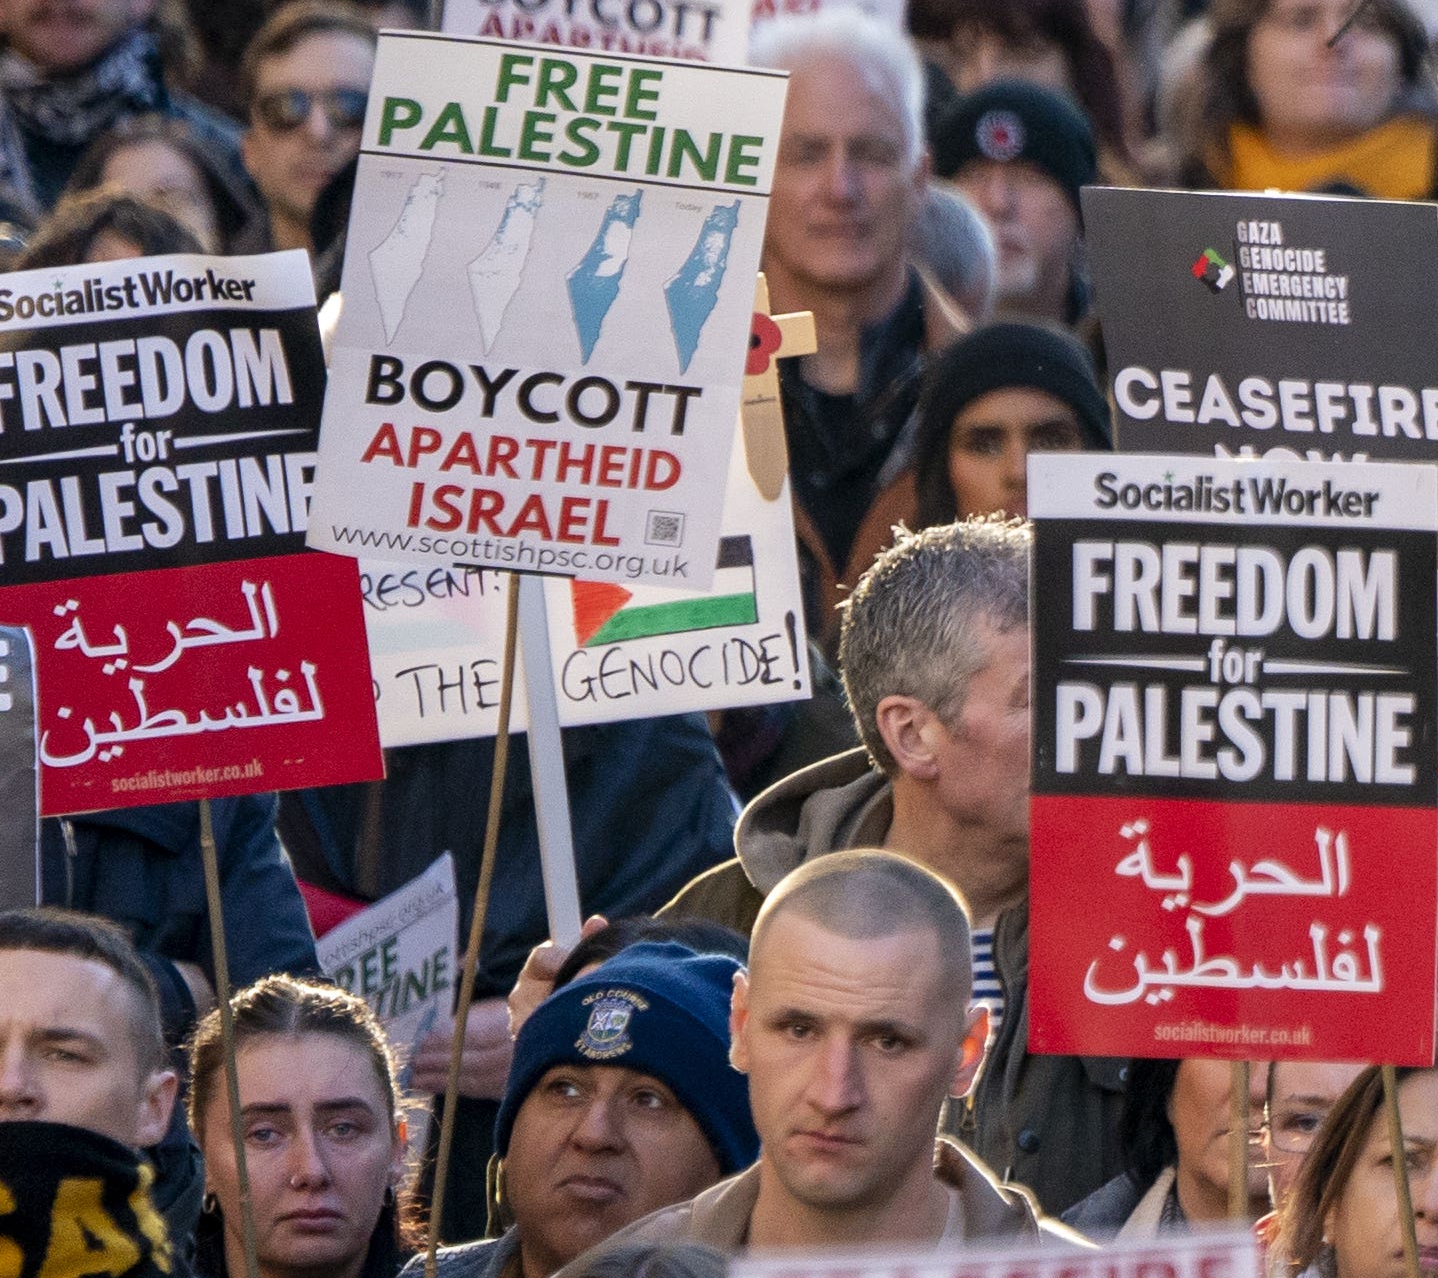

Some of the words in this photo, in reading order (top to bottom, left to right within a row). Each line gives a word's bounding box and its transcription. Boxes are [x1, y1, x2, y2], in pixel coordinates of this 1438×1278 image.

[498, 54, 664, 120] FREE
[377, 98, 764, 187] PALESTINE
[674, 200, 705, 215] Today
[1237, 220, 1283, 245] GAZA
[1239, 245, 1326, 273] GENOCIDE
[1243, 273, 1348, 301] EMERGENCY
[1246, 298, 1349, 324] COMMITTEE
[0, 327, 295, 433] FREEDOM
[364, 355, 703, 438] BOYCOTT
[119, 424, 171, 465] for
[361, 422, 683, 493] APARTHEID
[0, 452, 314, 567] PALESTINE
[408, 482, 623, 546] ISRAEL
[332, 521, 689, 580] www.scottishpsc.org.uk
[1073, 540, 1396, 641] FREEDOM
[397, 661, 500, 721] THE
[561, 610, 803, 703] GENOCIDE!
[1207, 639, 1263, 684] for
[1055, 682, 1415, 786] PALESTINE
[109, 757, 264, 794] socialistworker.co.uk
[1154, 1023, 1311, 1048] socialistworker.co.uk
